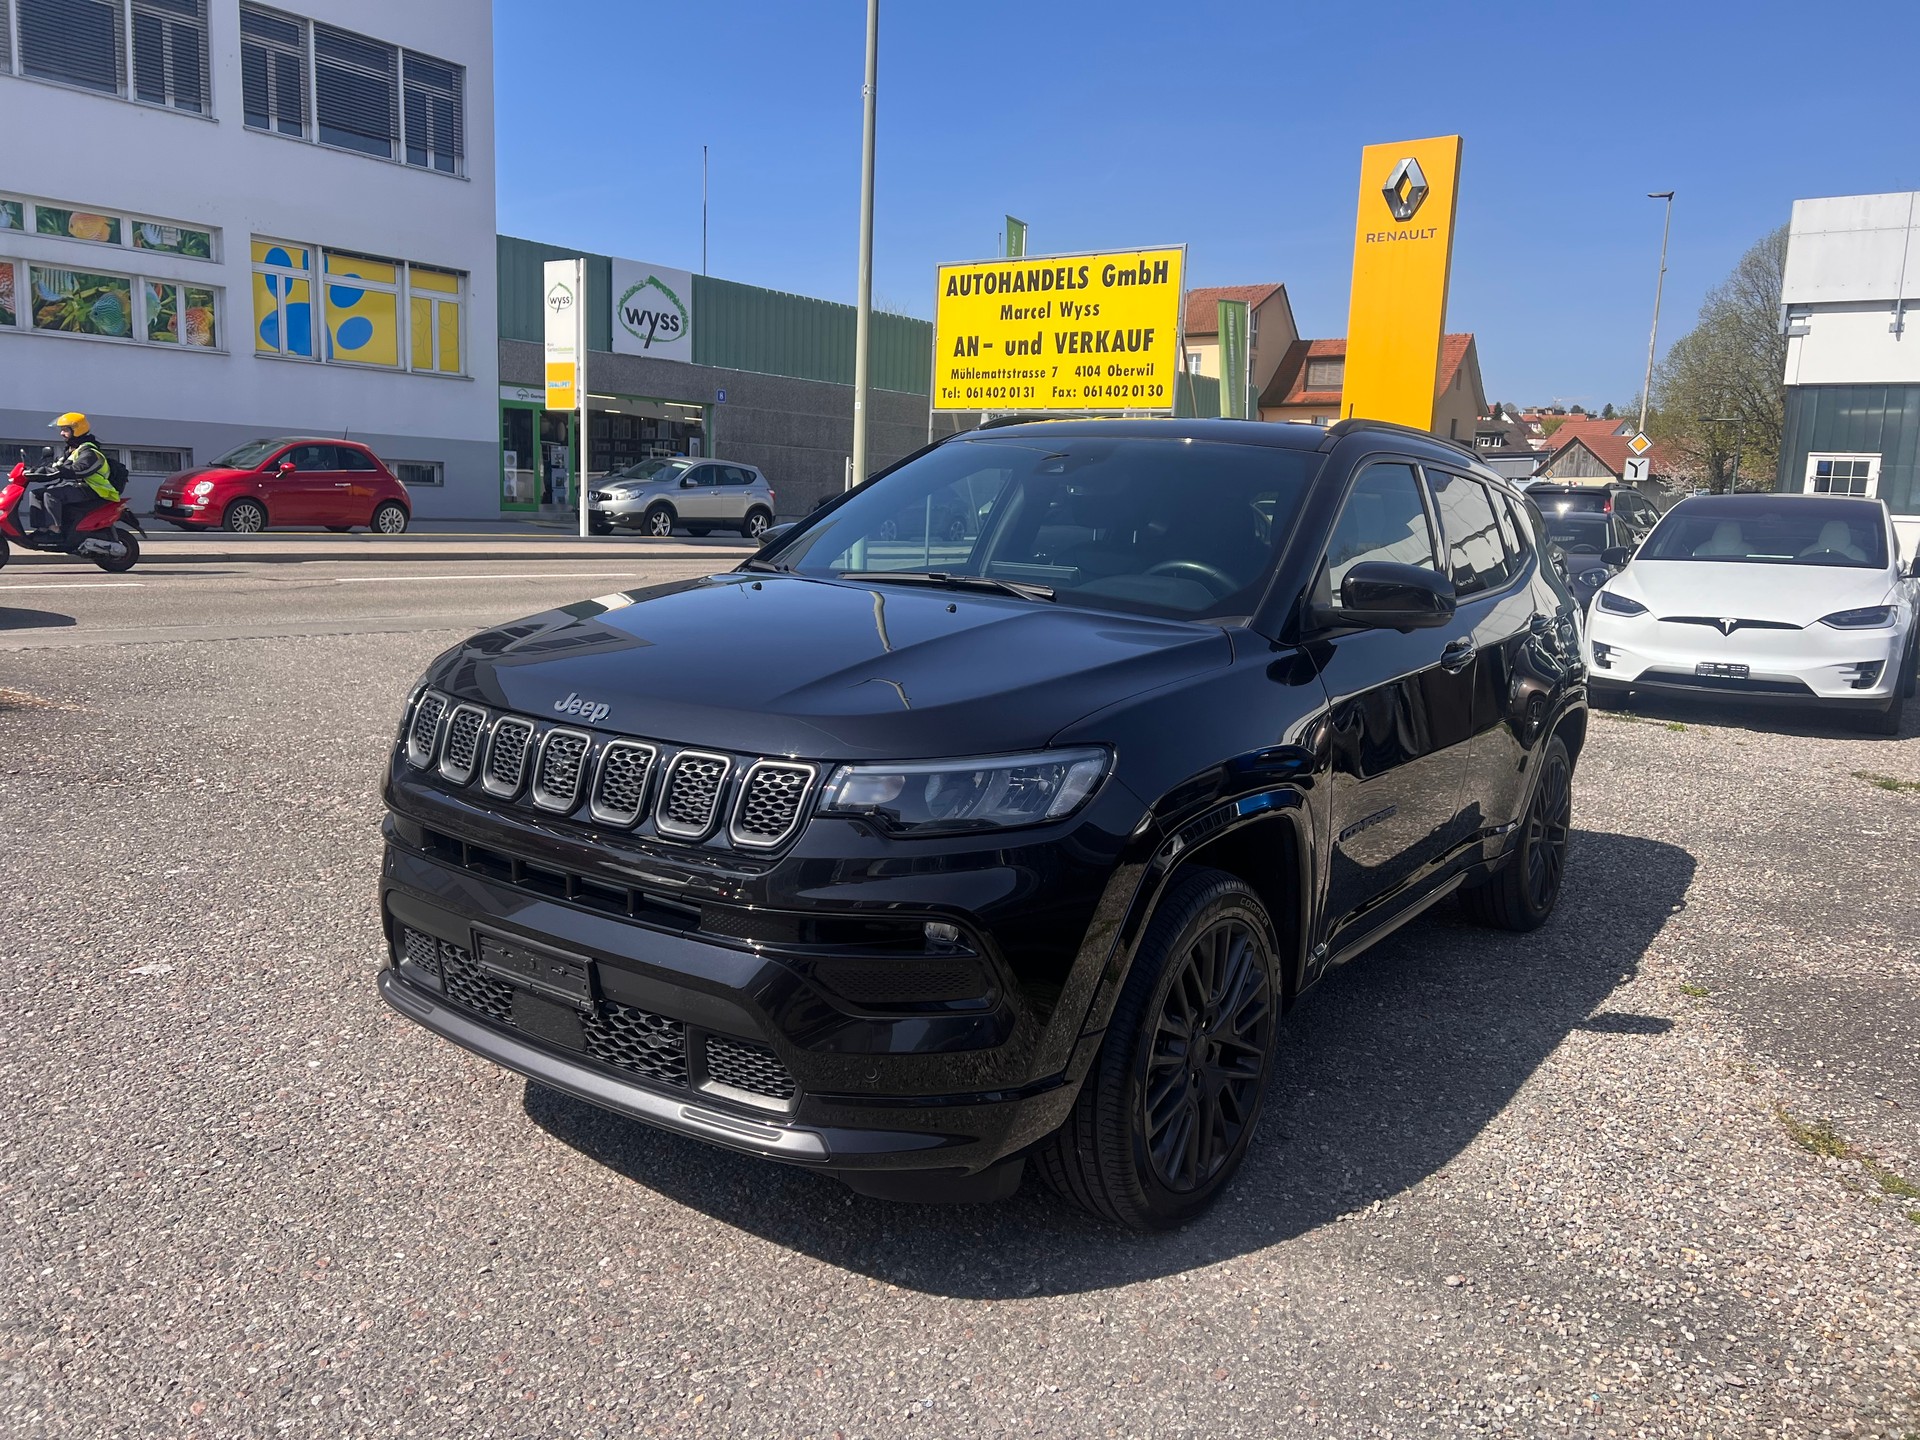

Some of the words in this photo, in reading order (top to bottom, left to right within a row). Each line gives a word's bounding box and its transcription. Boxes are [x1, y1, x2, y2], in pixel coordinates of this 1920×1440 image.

[1366, 228, 1438, 244] RENAULT
[946, 266, 1089, 297] AUTOHANDELS
[1102, 260, 1169, 288] GmbH
[550, 296, 570, 314] wyss
[1000, 301, 1051, 321] Marcel
[1060, 301, 1100, 321] Wyss
[624, 307, 680, 350] wyss
[954, 336, 993, 358] AN-
[1006, 332, 1043, 357] und
[1055, 329, 1155, 354] VERKAUF
[951, 368, 1046, 380] Mühlemattstrasse
[1051, 366, 1058, 378] 7
[1075, 366, 1101, 378] 4104
[1108, 363, 1154, 377] Oberwil
[943, 387, 961, 399] Tel:
[1053, 386, 1077, 398] Fax:
[554, 692, 611, 723] Jeep
[1239, 897, 1269, 928] COOPER
